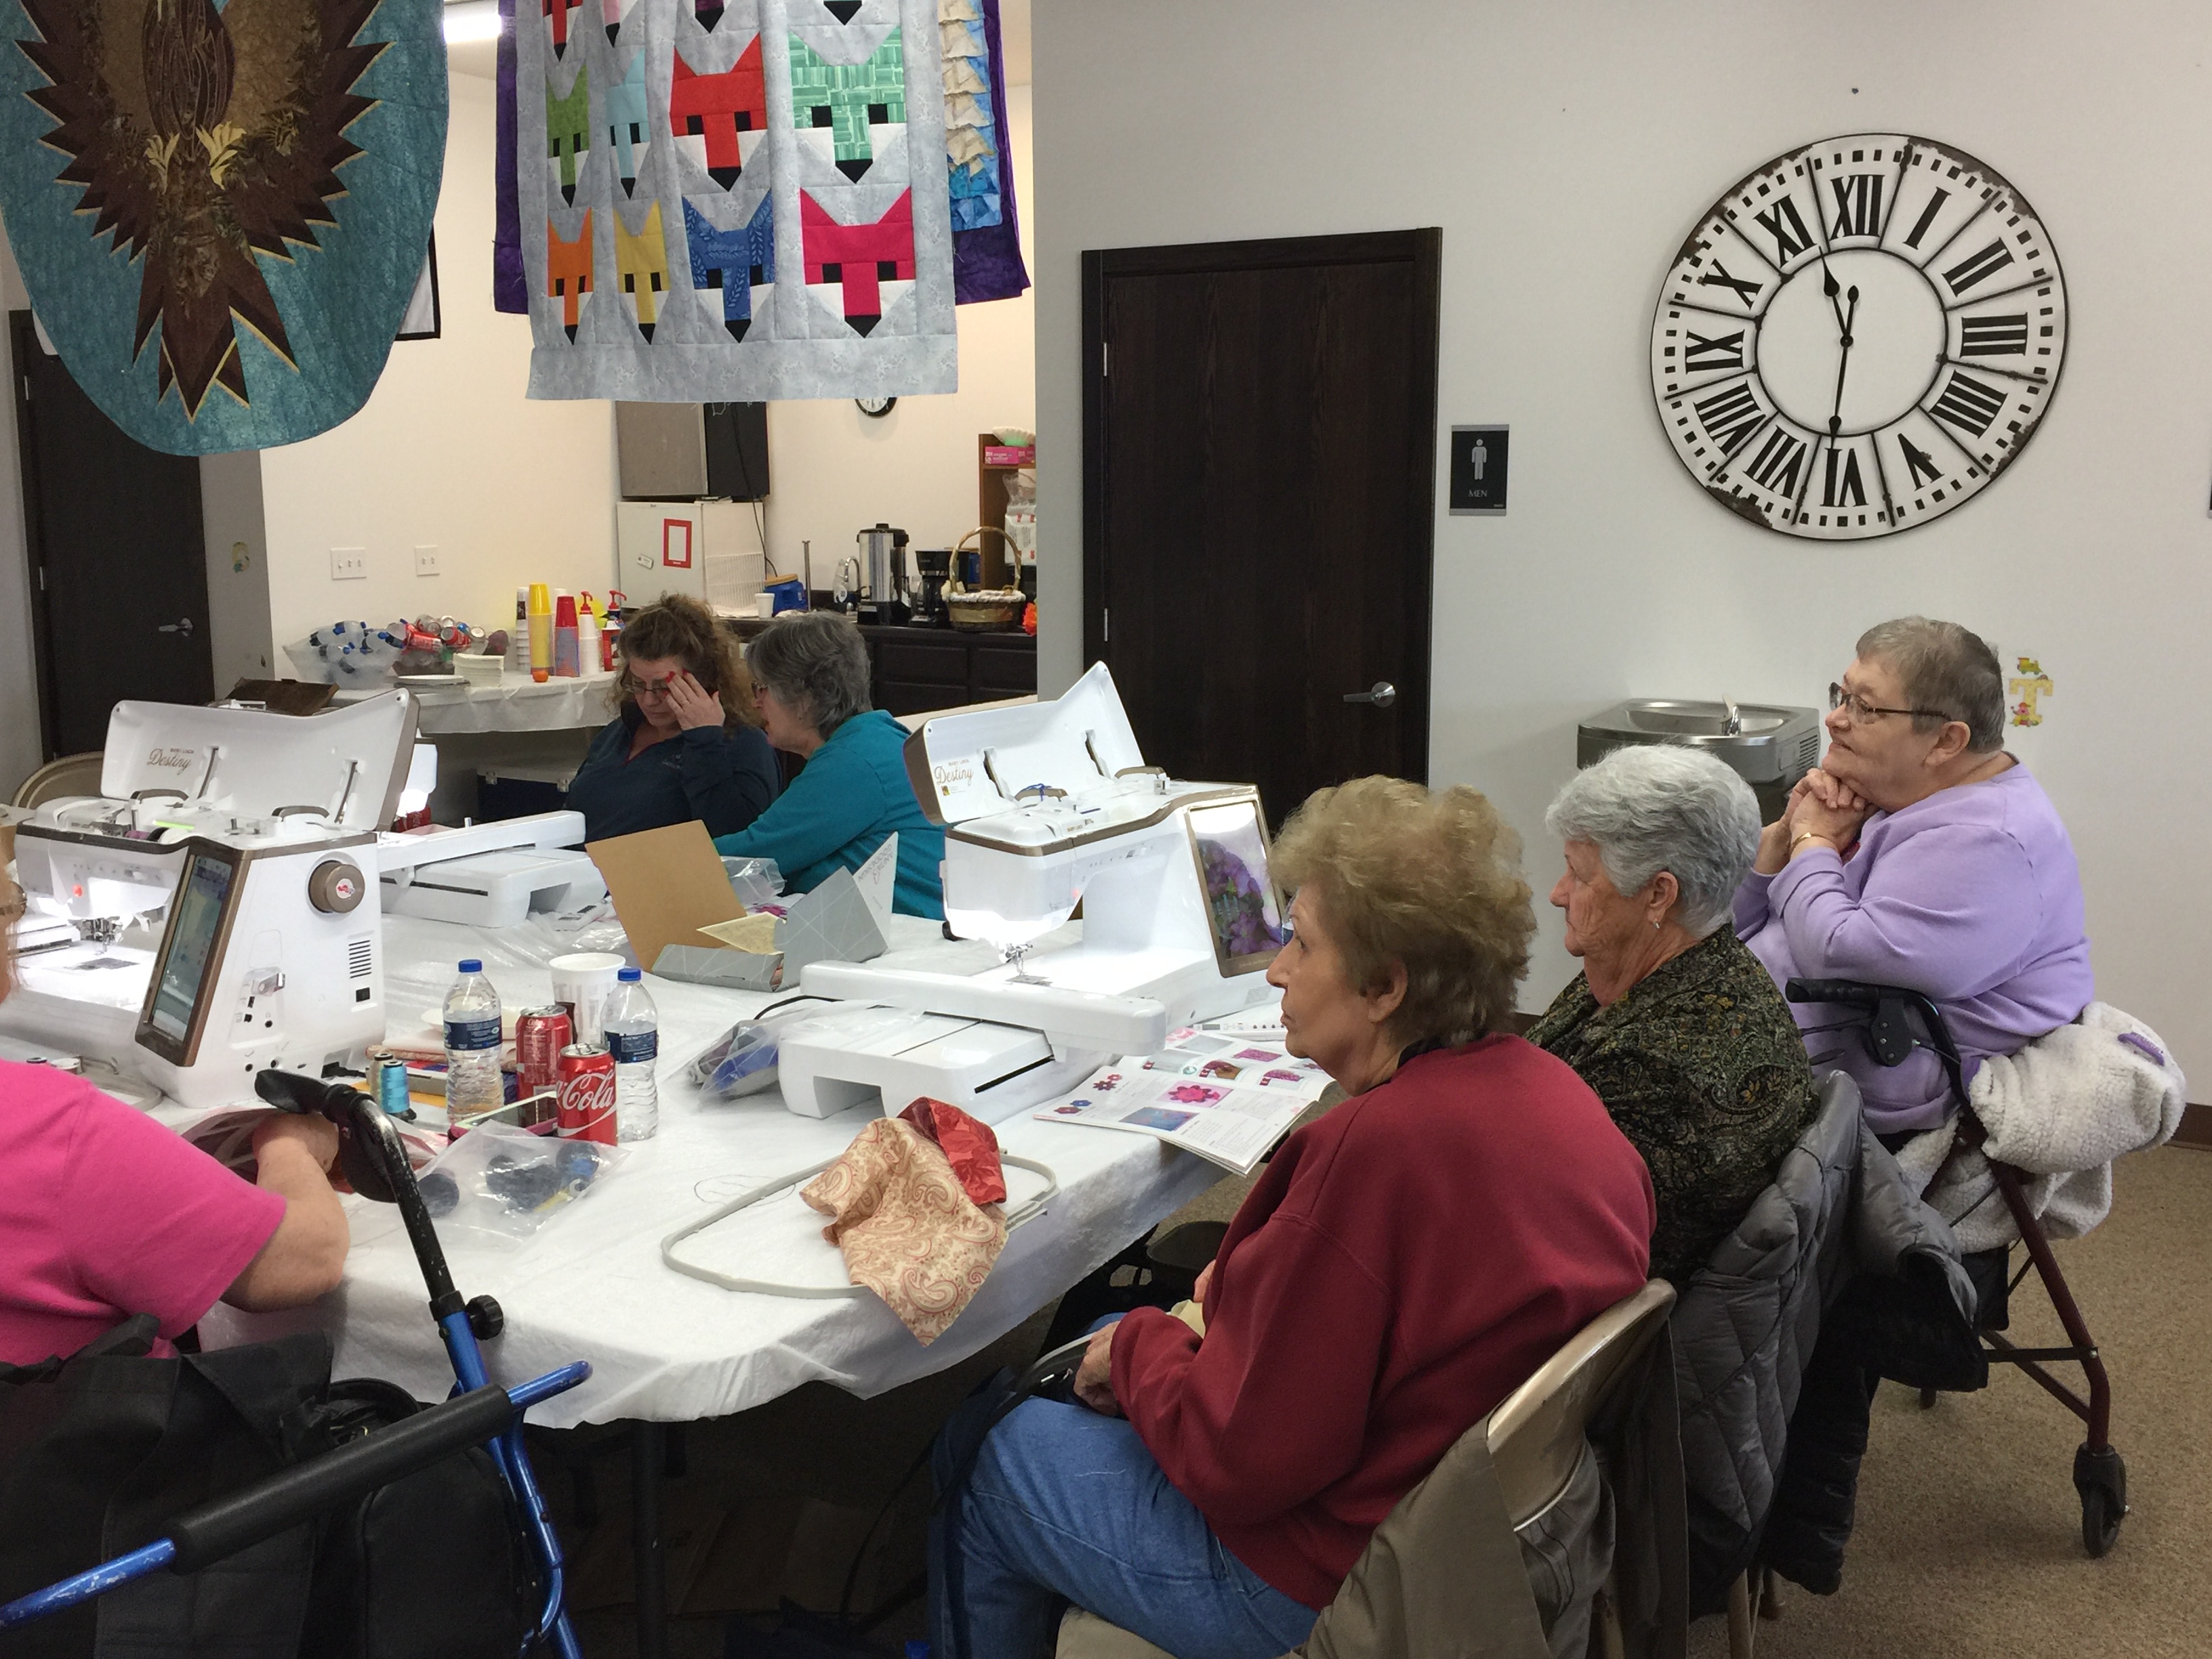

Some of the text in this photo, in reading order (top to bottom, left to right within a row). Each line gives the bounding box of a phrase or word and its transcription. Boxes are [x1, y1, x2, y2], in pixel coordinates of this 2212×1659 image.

[1753, 194, 1818, 268] XI
[1830, 174, 1885, 241] XII
[1702, 259, 1763, 310] X
[1942, 237, 2015, 297] II
[1685, 329, 1744, 375] IX
[1959, 312, 2028, 357] III
[1693, 380, 1767, 457] VIII
[1929, 369, 2008, 438] IIII
[1743, 425, 1807, 499] VII
[1820, 447, 1869, 508] VI
[1898, 433, 1944, 491] V
[1468, 489, 1488, 497] MEN
[146, 748, 191, 775] Destiny
[934, 765, 974, 786] Destiny
